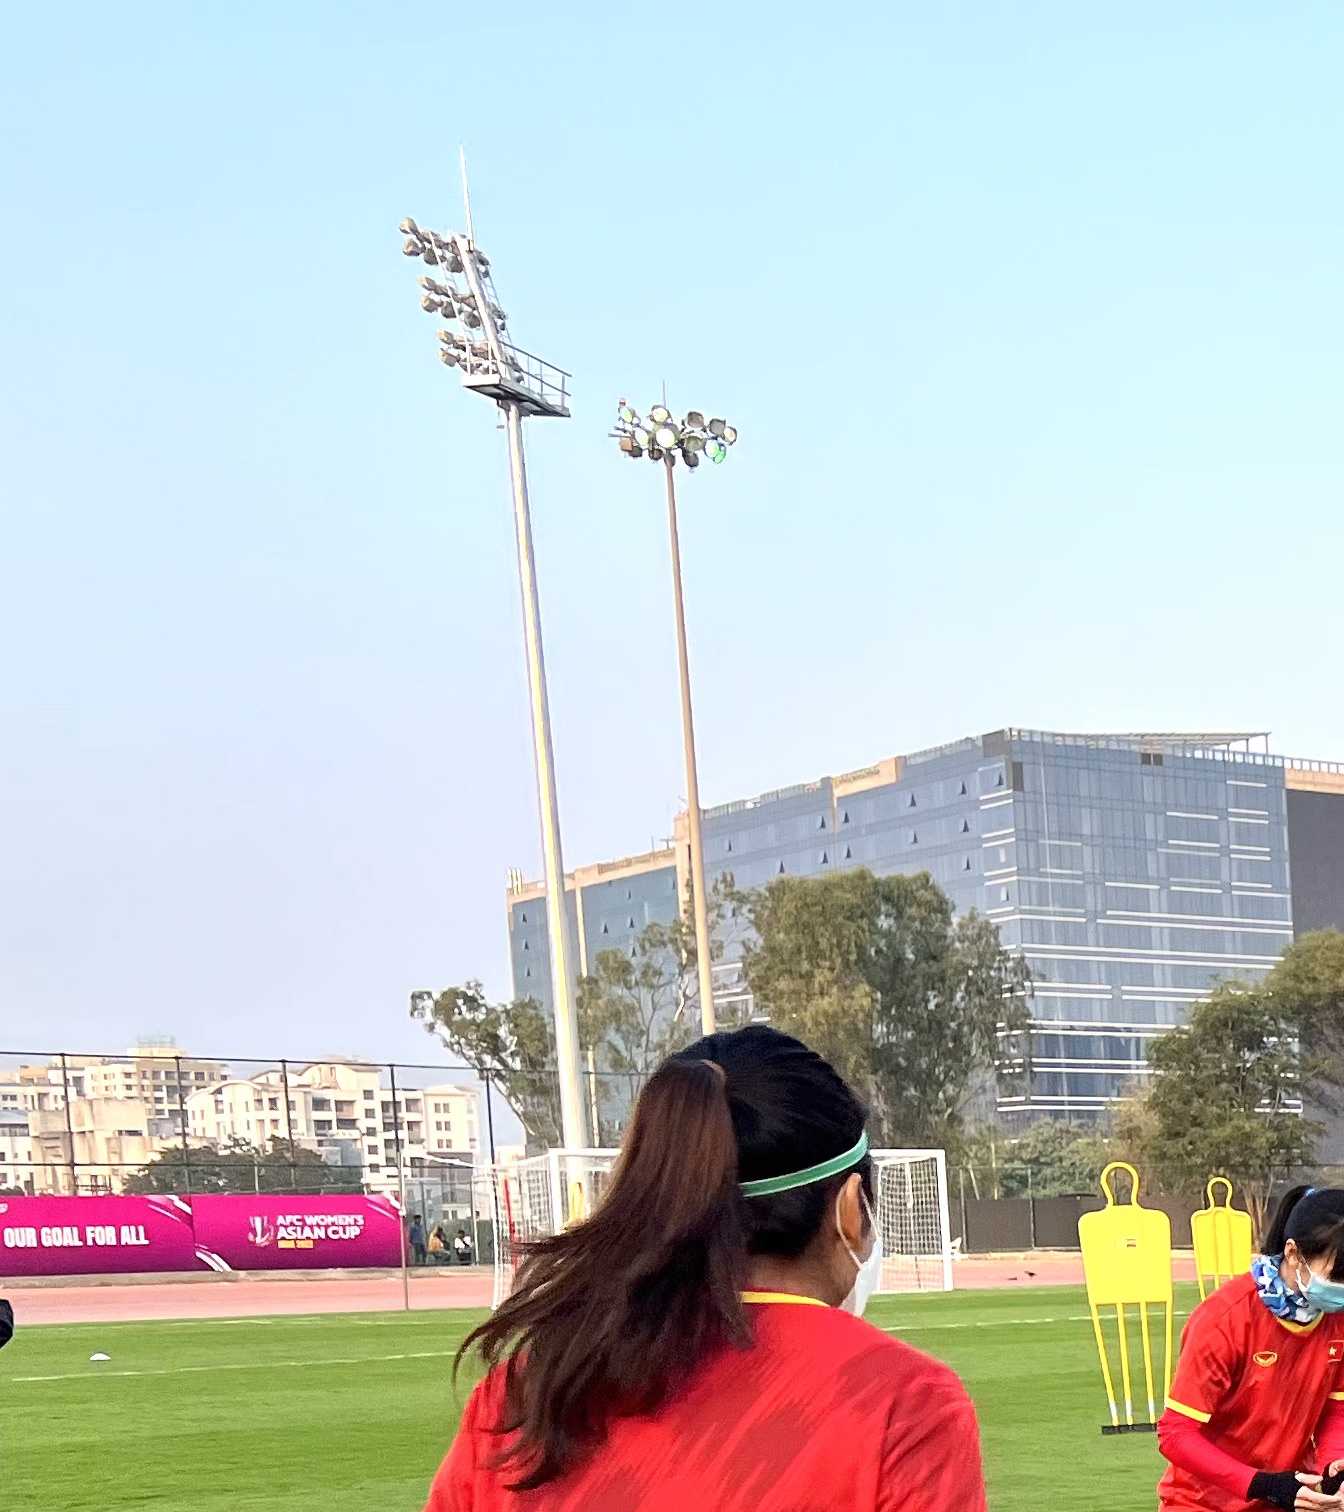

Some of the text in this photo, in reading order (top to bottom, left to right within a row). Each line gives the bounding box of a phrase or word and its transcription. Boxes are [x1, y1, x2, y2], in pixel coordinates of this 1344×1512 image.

[276, 1214, 365, 1226] AFC WOMEN'S
[3, 1225, 150, 1248] OUR GOAL FOR ALL
[276, 1225, 361, 1240] ASIAN CUP
